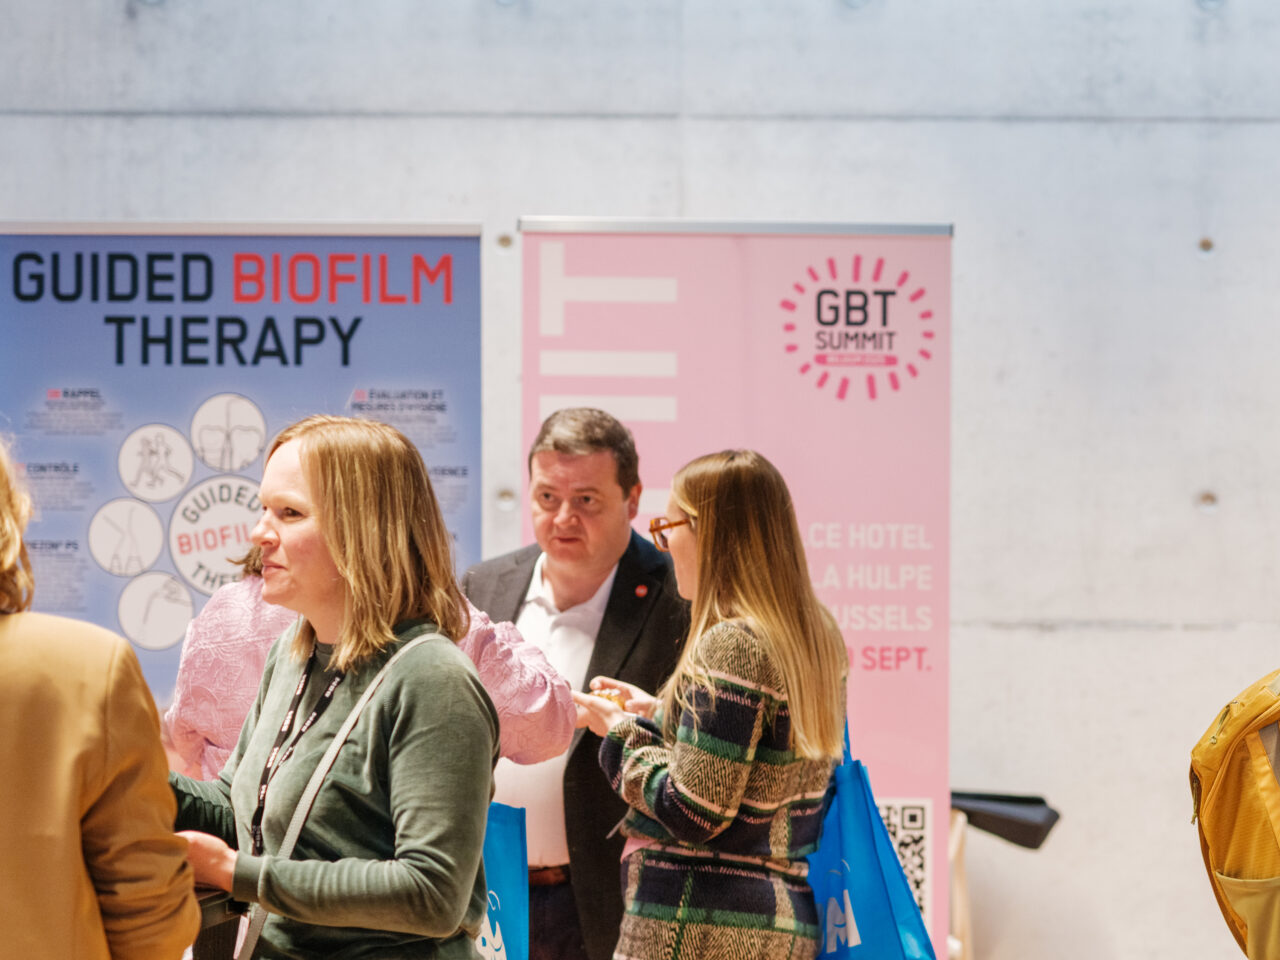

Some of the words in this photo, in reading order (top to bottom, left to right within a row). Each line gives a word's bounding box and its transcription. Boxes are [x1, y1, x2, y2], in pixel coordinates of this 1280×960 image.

[13, 253, 213, 302] GUIDED
[233, 254, 453, 304] BIOFILM
[817, 290, 896, 326] GBT
[105, 317, 363, 366] THERAPY
[816, 331, 896, 350] SUMMIT
[178, 523, 252, 555] BIOFIL
[848, 523, 933, 550] HOTEL
[847, 564, 932, 591] HULPE
[832, 604, 933, 631] USSELS
[861, 646, 933, 671] SEPT.
